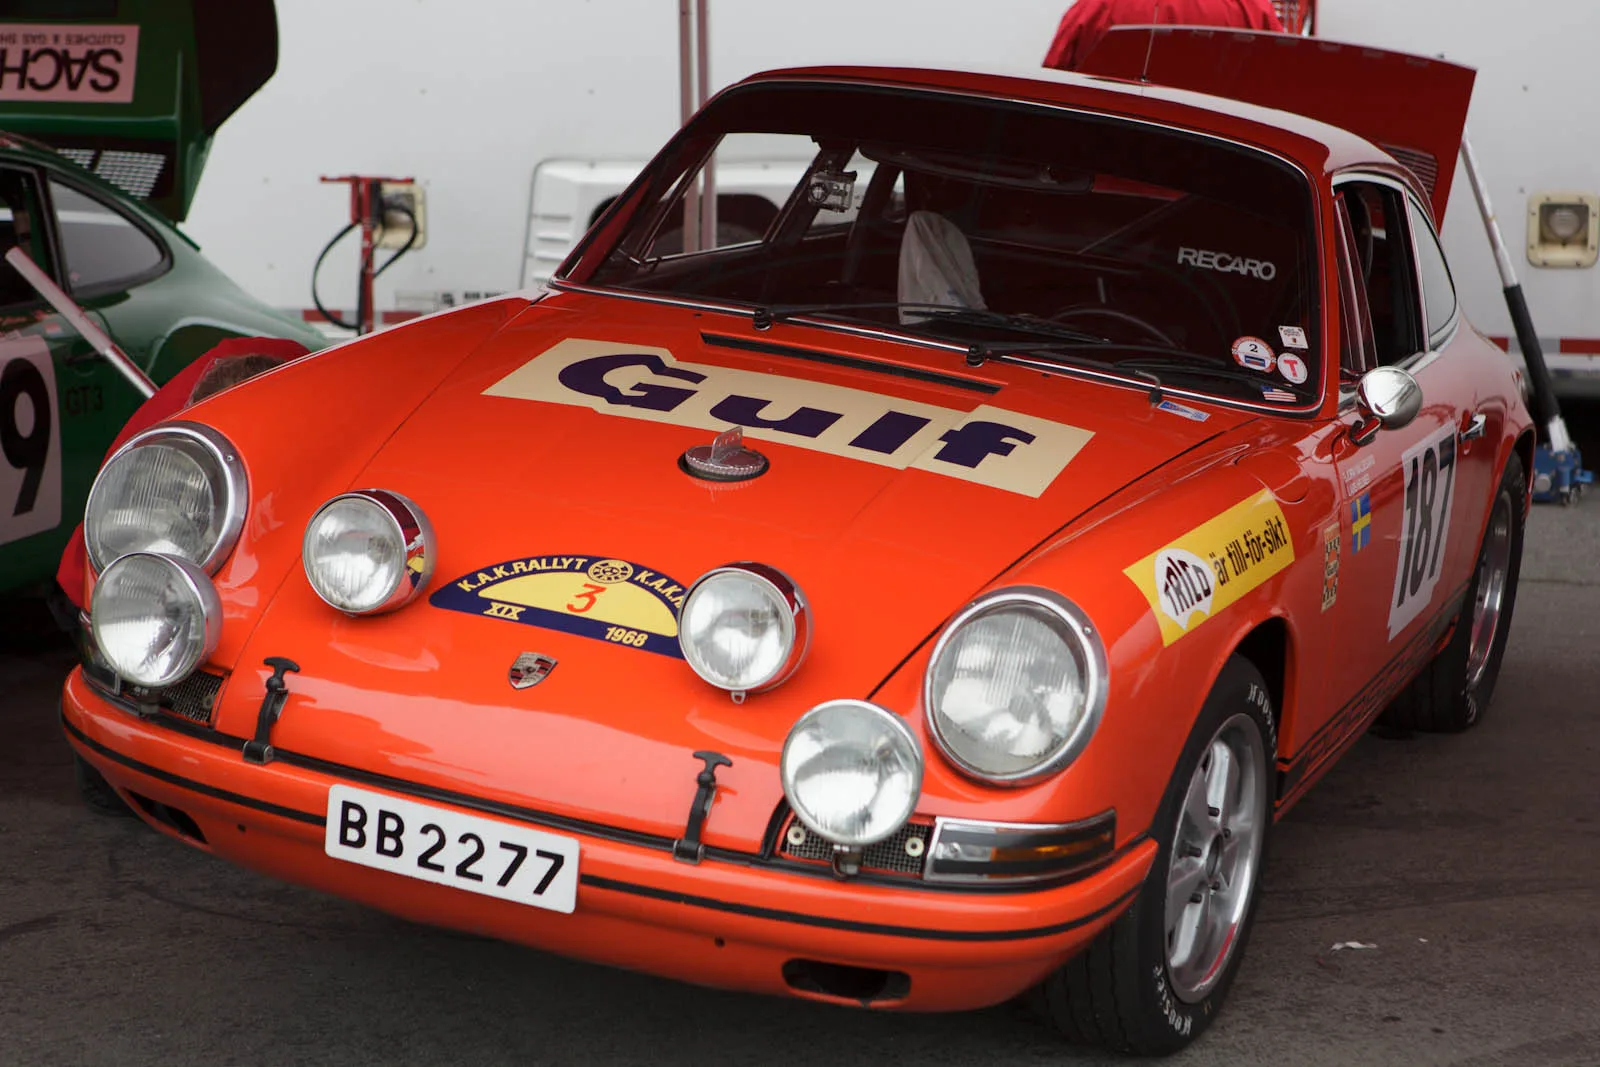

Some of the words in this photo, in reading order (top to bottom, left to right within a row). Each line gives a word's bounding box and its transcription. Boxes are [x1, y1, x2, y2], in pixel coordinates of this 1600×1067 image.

[1177, 246, 1276, 281] RECARO
[1248, 343, 1259, 353] 2
[1283, 359, 1299, 378] T
[558, 353, 1037, 469] Gulf
[0, 358, 52, 517] 9
[1397, 433, 1456, 608] 187
[1208, 551, 1230, 587] är
[1225, 515, 1288, 577] till-för-sikt
[565, 583, 608, 614] 3
[483, 601, 526, 621] XIX
[604, 626, 649, 648] 1968
